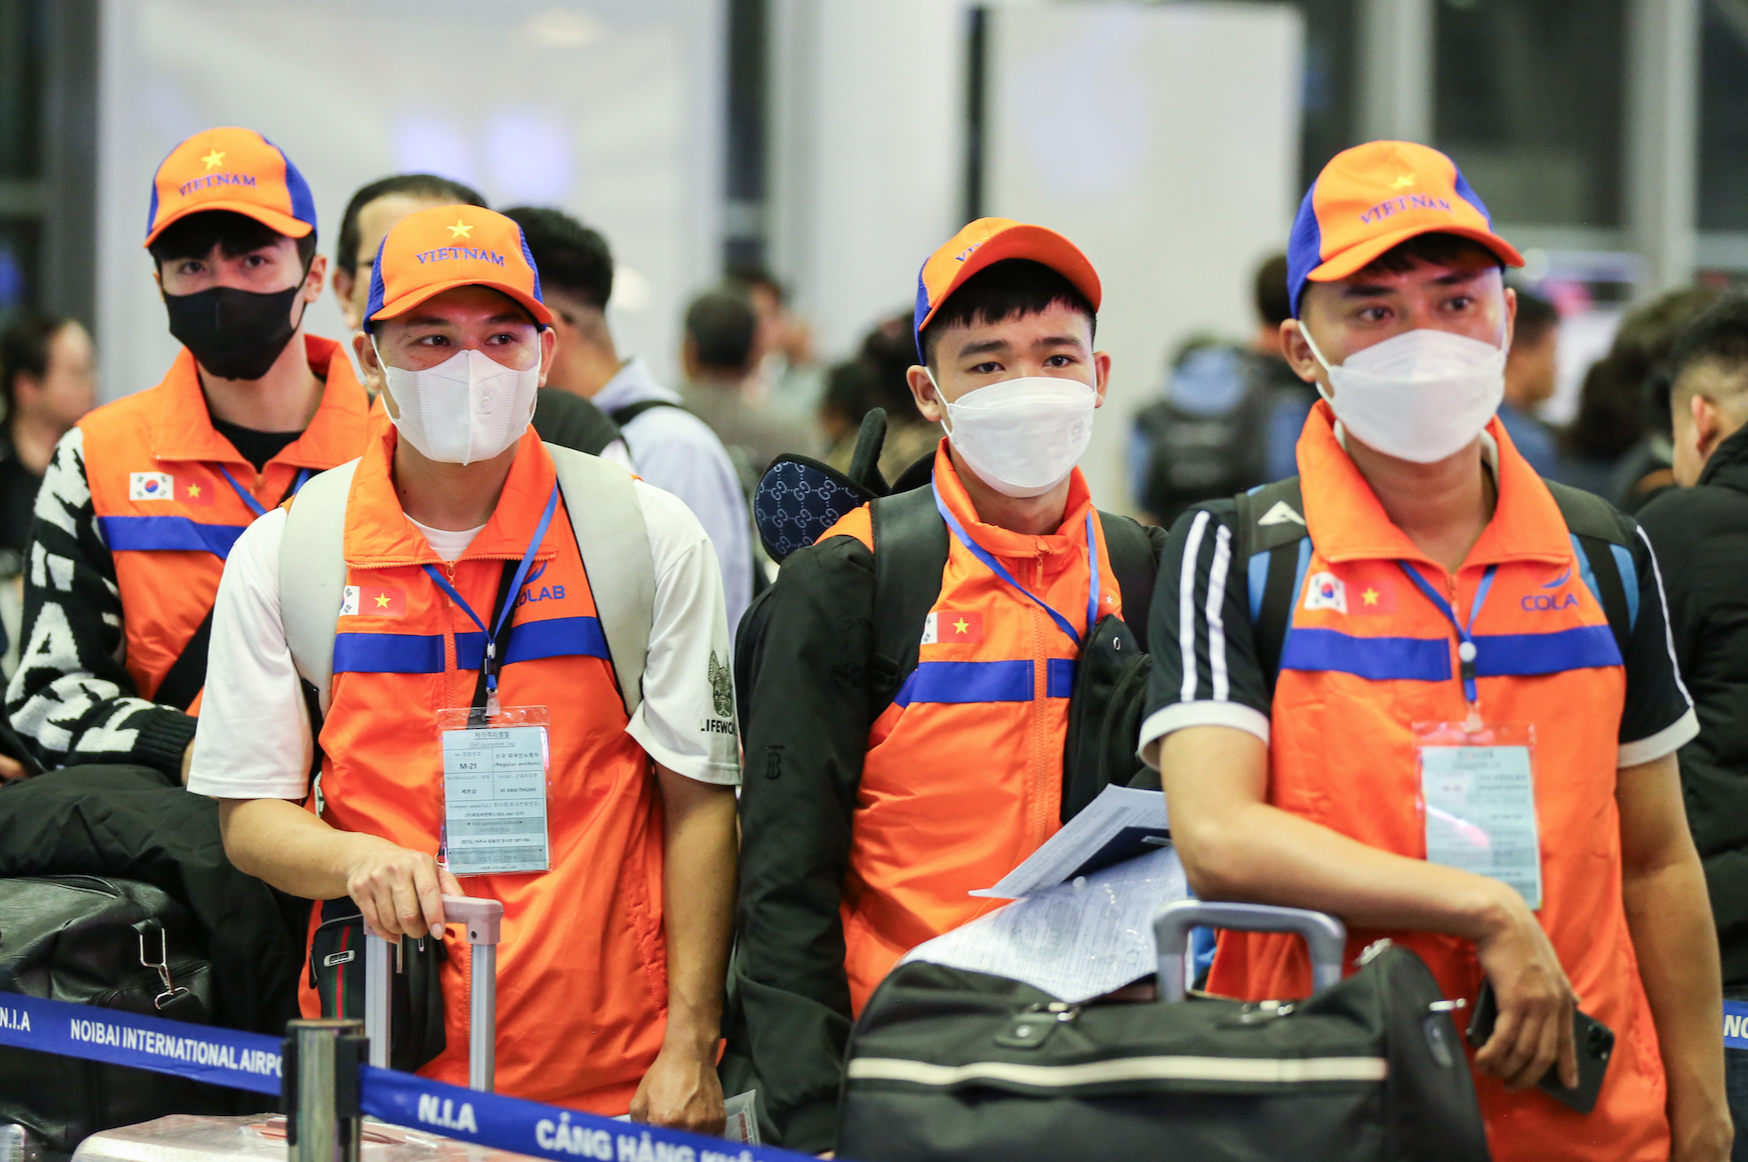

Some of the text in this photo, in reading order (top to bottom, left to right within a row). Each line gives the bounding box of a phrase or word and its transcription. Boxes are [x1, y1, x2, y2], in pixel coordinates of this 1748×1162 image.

[179, 172, 258, 197] VIETNAM
[1359, 193, 1453, 225] VIETNAM
[416, 246, 506, 268] VIETNAM
[516, 585, 566, 608] OLAB
[0, 1006, 31, 1032] N.I.A
[70, 1018, 120, 1047] NOIBAI
[122, 1026, 239, 1070] INTERNATIONAL
[418, 1093, 478, 1134] N.I.A
